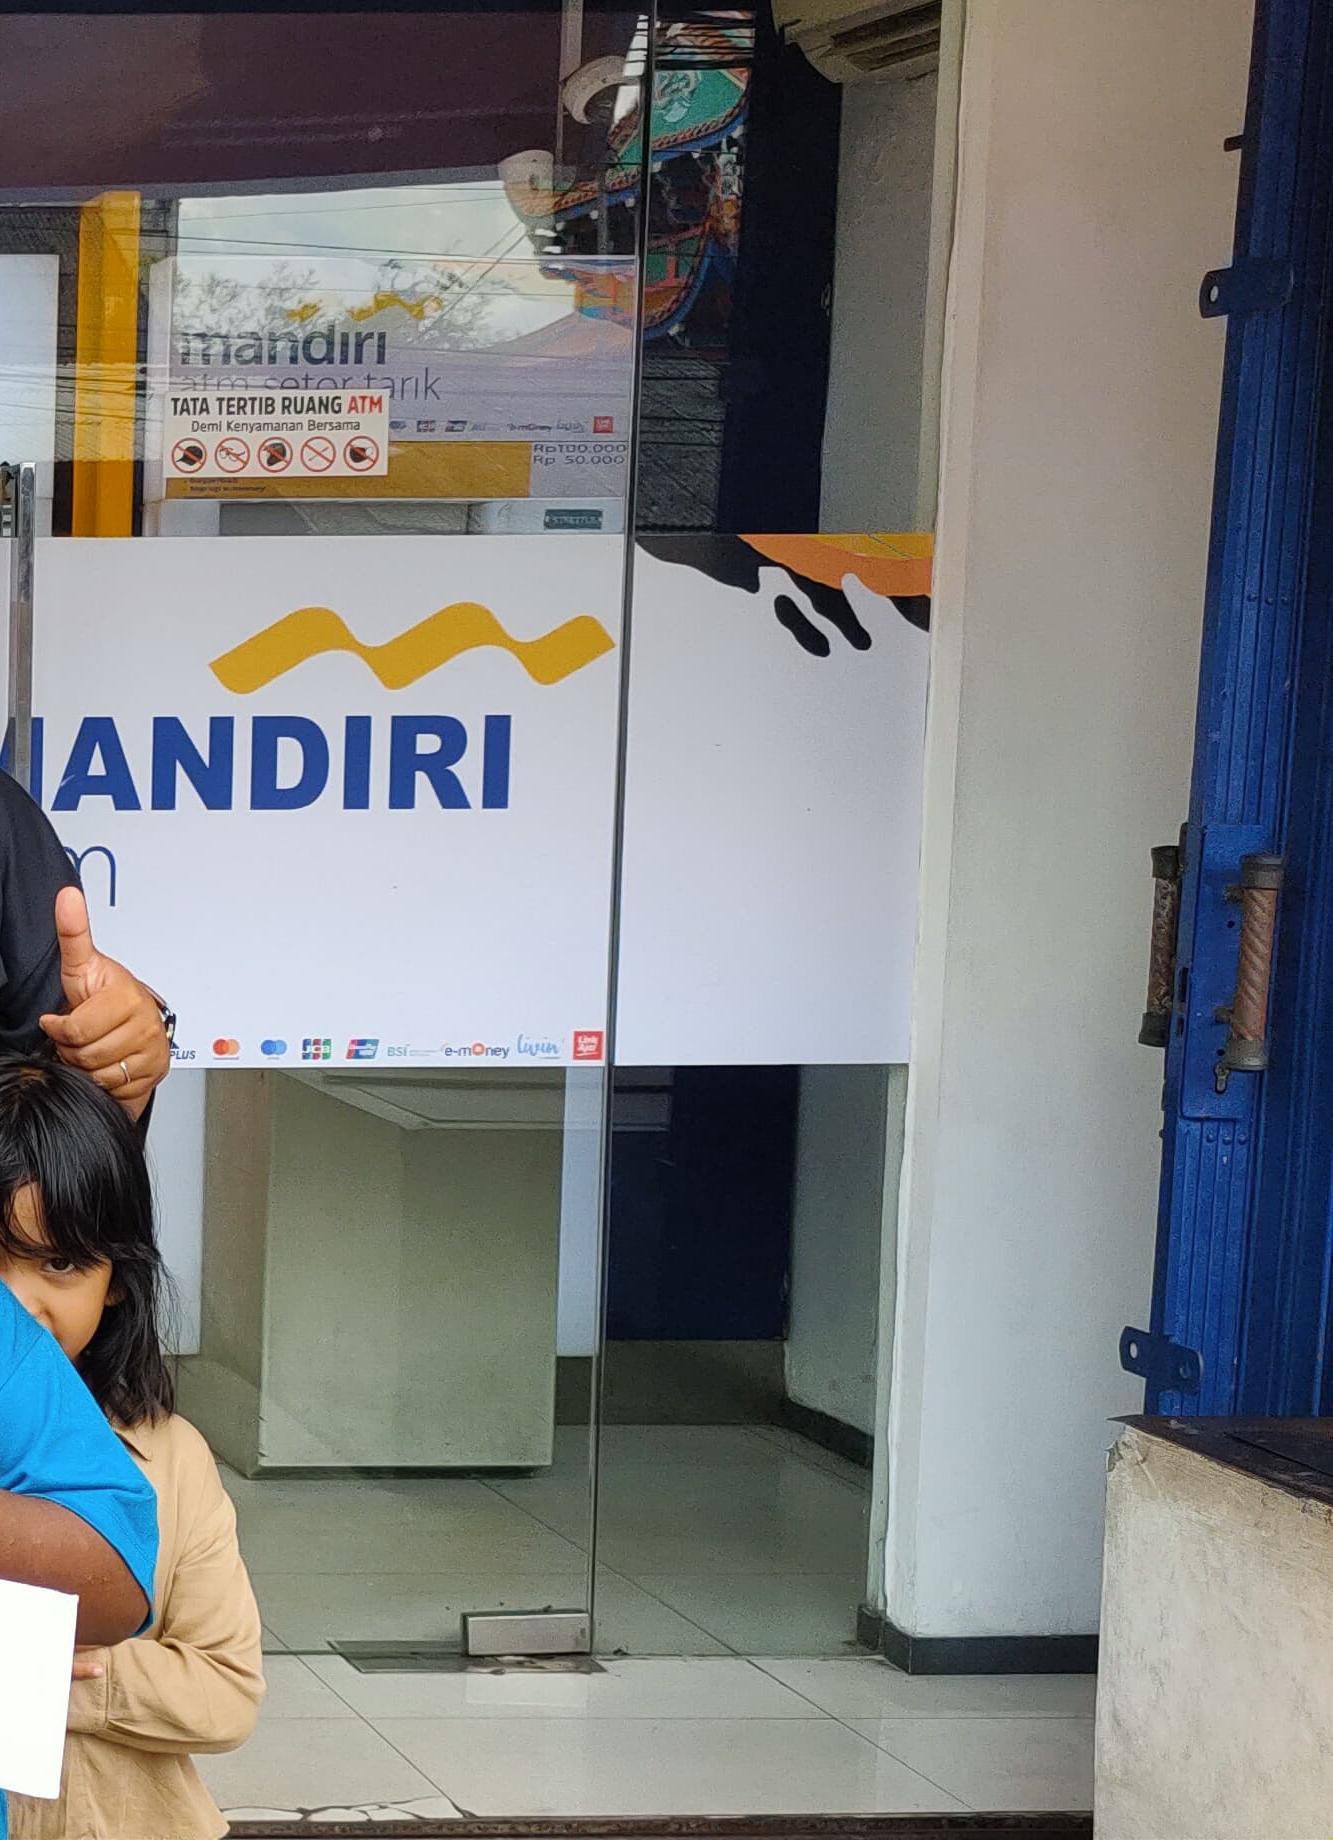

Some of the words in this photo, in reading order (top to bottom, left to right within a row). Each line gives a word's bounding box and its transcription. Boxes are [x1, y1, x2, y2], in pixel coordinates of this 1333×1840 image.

[180, 324, 387, 365] mandiri
[170, 397, 211, 416] TATA
[216, 396, 276, 416] TERTIB
[282, 395, 342, 415] RUANG
[347, 395, 383, 414] ATM
[191, 420, 222, 432] Demi
[226, 420, 304, 434] Kenyamanan
[308, 419, 361, 432] Bersama
[564, 455, 626, 465] 50.000
[444, 1042, 509, 1059] e-money
